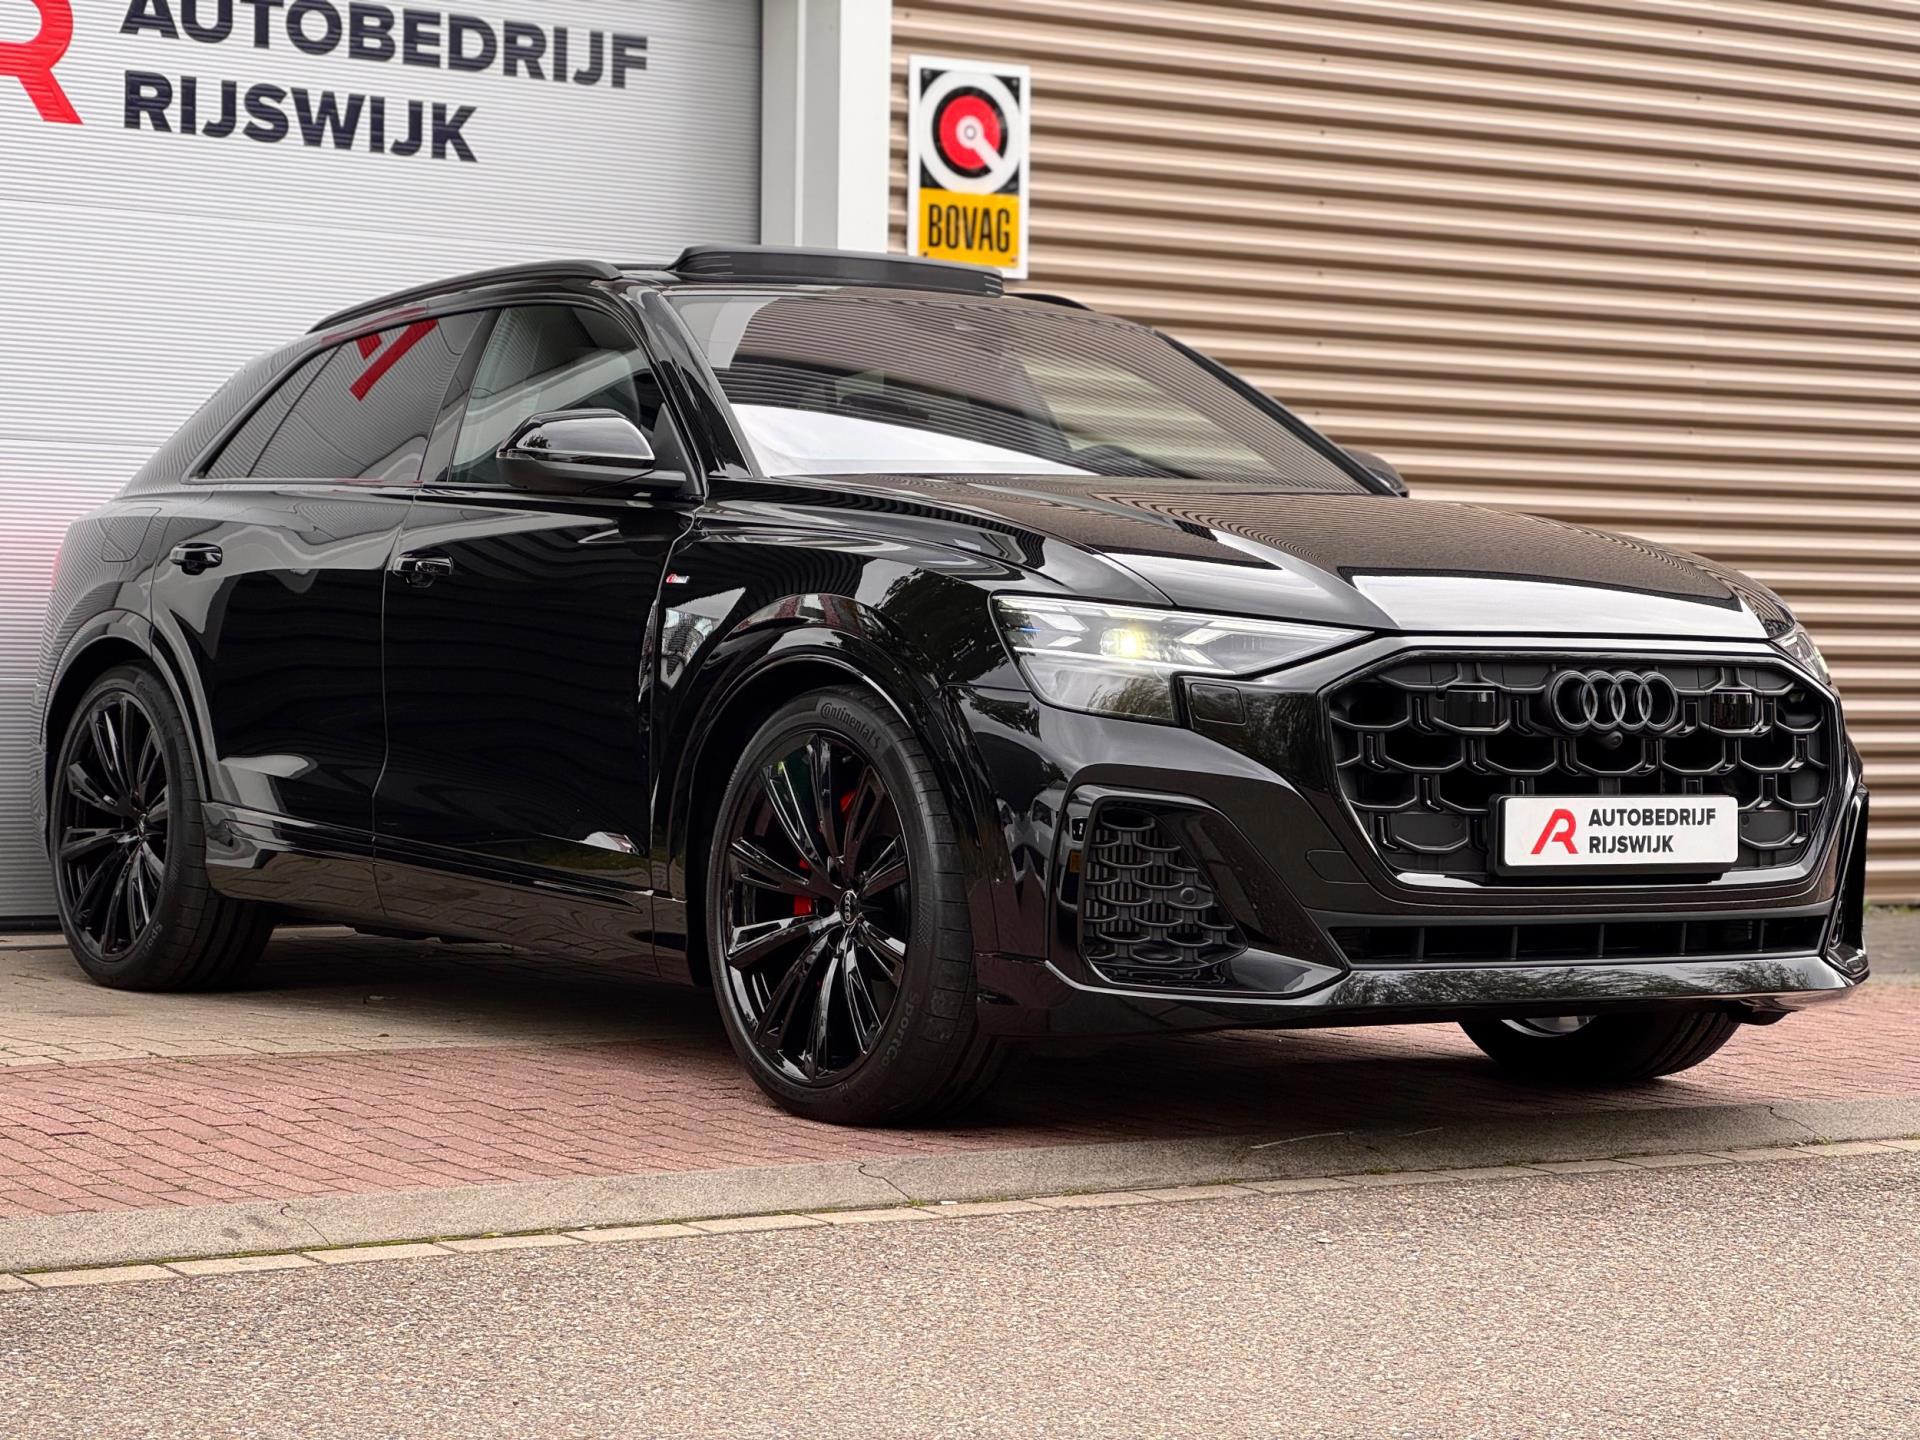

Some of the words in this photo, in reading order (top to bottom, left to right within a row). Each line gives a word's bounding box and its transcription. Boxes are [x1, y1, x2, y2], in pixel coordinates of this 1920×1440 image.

[119, 0, 648, 89] AUTOBEDRIJF
[124, 69, 478, 163] RIJSWIJK
[928, 204, 1011, 253] BOVAG
[820, 702, 876, 743] Continental
[1588, 808, 1716, 827] AUTOBEDRIJF
[1588, 835, 1674, 854] RIJSWIJK
